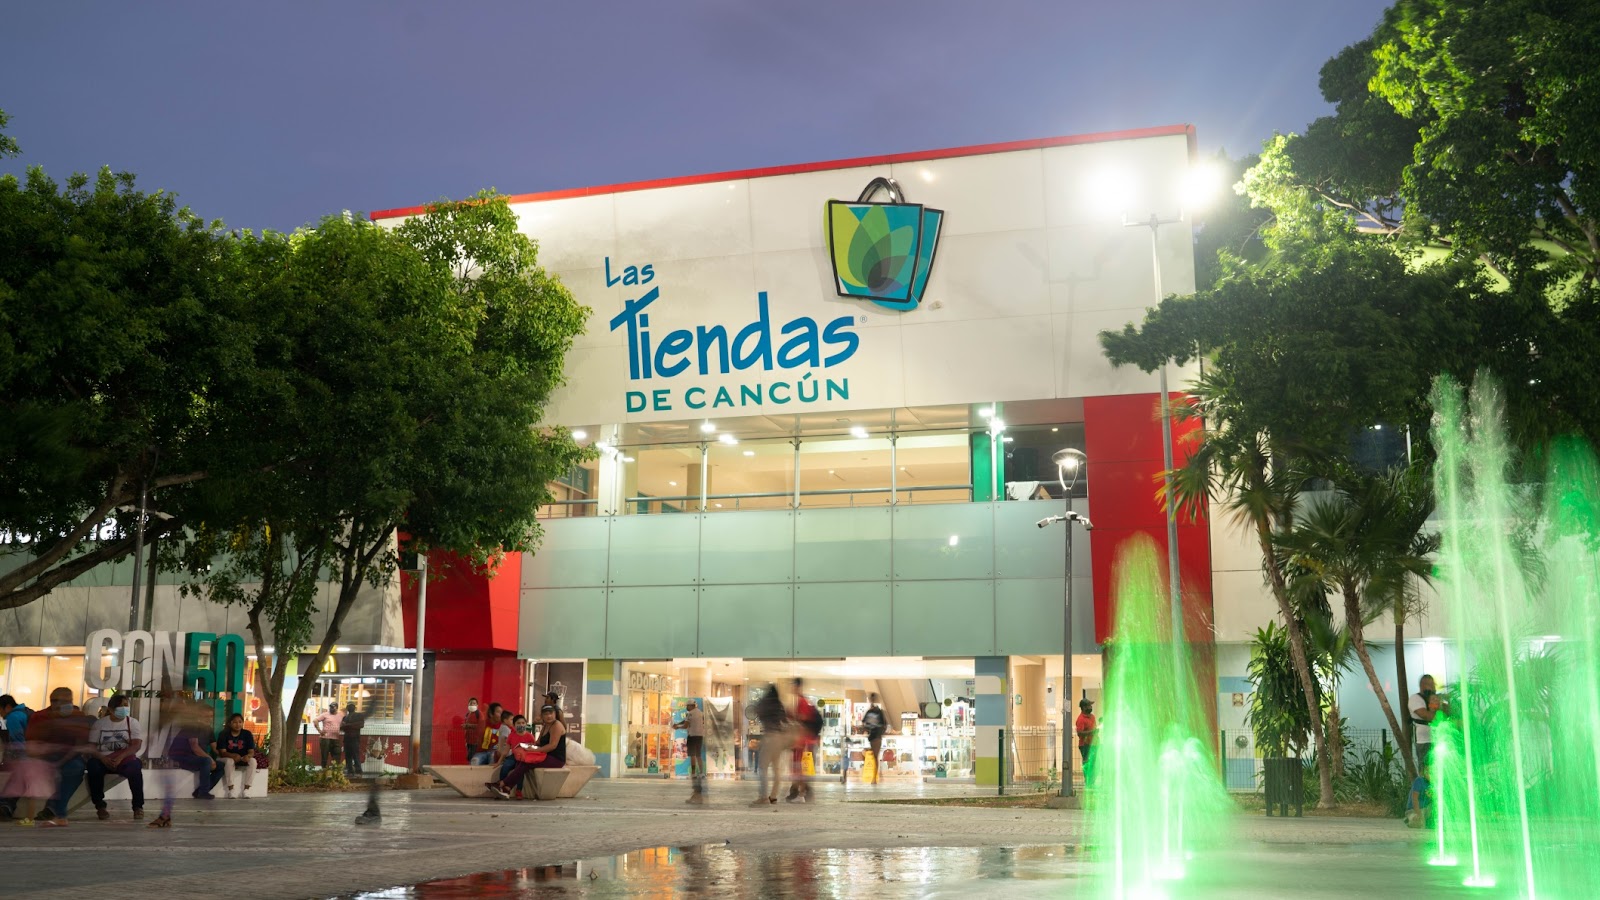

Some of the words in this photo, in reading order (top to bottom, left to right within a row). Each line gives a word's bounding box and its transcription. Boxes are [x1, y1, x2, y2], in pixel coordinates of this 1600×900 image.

[605, 256, 655, 288] Las
[609, 286, 860, 380] Tiendas
[626, 388, 672, 413] DE
[684, 372, 849, 410] CANCÚN
